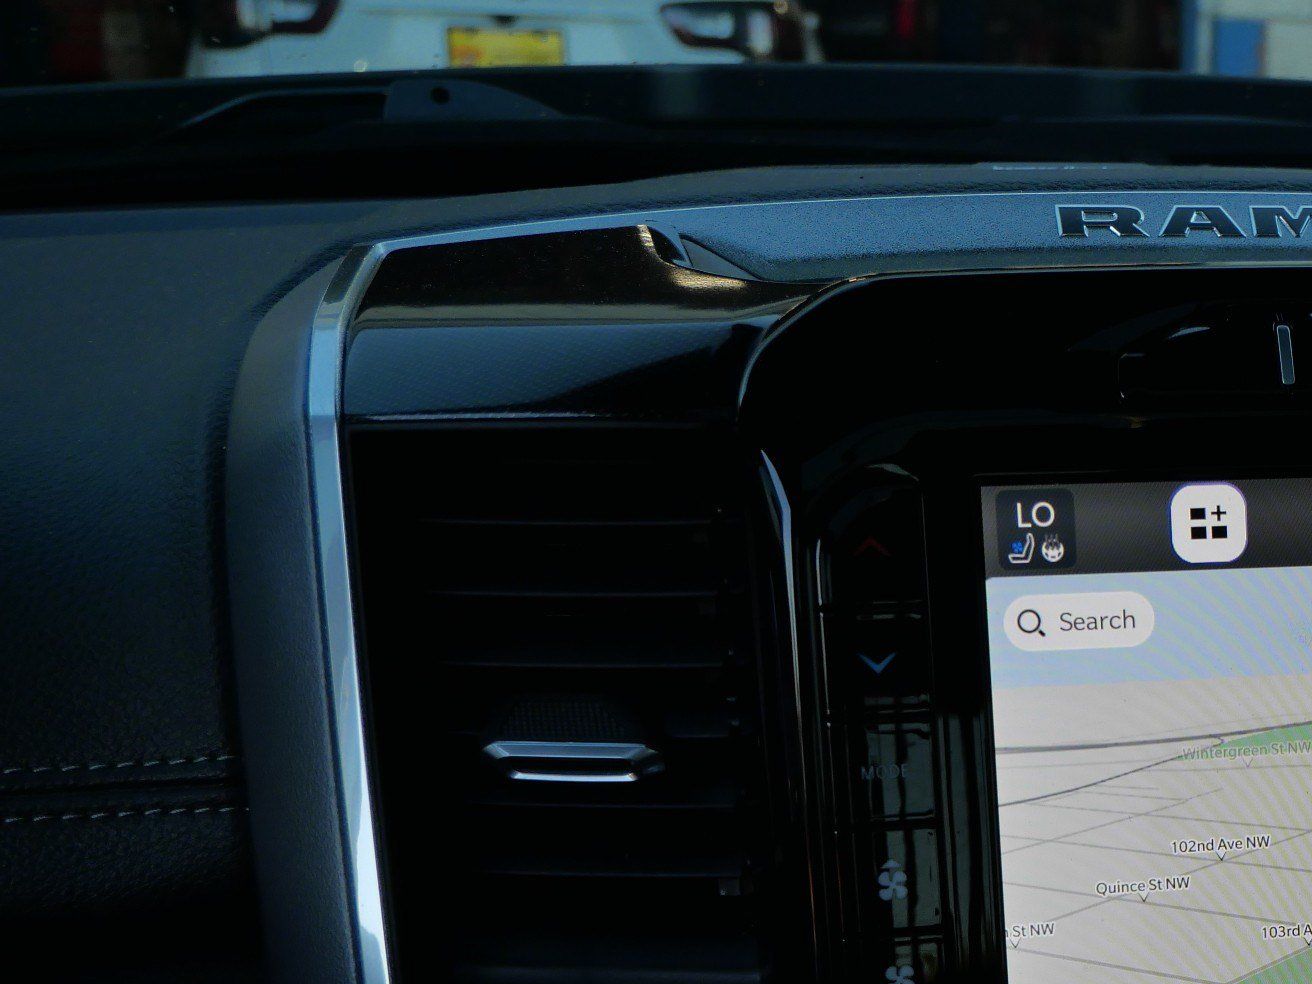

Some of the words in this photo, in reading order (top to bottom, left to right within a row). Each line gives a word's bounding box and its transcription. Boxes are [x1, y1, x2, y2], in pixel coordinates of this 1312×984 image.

[1015, 501, 1056, 529] LO
[1059, 609, 1137, 632] Search
[1183, 744, 1268, 760] Wintergreen
[1271, 742, 1284, 755] St
[1287, 741, 1311, 754] NW
[1172, 838, 1214, 853] 102nd
[1217, 837, 1243, 851] Ave
[1246, 835, 1271, 849] NW
[1096, 880, 1146, 896] Quince
[1149, 878, 1163, 892] St
[1165, 877, 1190, 890] NW
[1012, 925, 1027, 938] St
[1030, 923, 1055, 936] NW
[1262, 925, 1301, 940] 103rd
